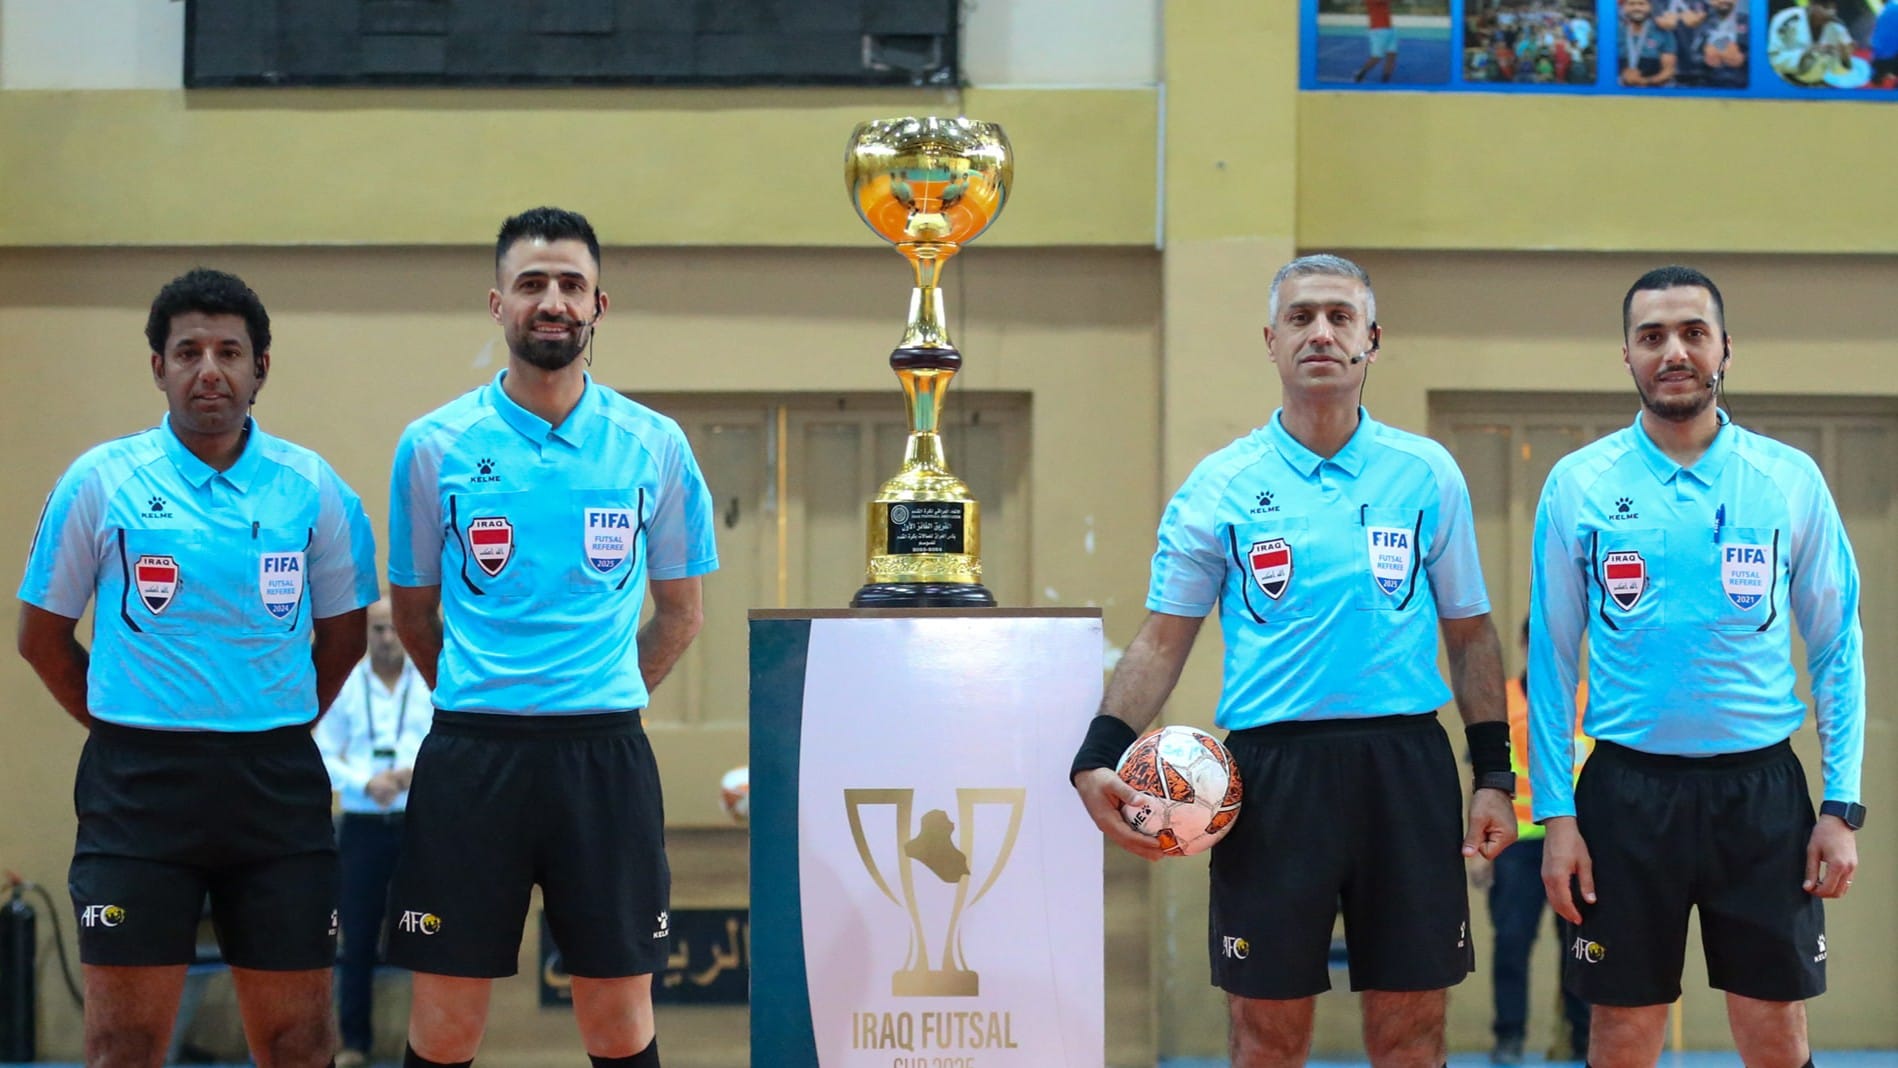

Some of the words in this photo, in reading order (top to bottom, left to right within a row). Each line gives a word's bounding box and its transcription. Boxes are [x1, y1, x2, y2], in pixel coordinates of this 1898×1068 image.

[470, 475, 501, 483] KELME
[1250, 506, 1280, 514] KELME
[590, 513, 629, 528] FIFA
[1608, 513, 1639, 521] KELME
[477, 520, 503, 528] IRAQ
[595, 535, 623, 544] FUTSAL
[1372, 531, 1408, 549] FIFA
[592, 543, 624, 551] REFEREE
[1257, 543, 1282, 552] IRAQ
[1378, 554, 1403, 563] FUTSAL
[1611, 554, 1636, 562] IRAQ
[1726, 547, 1766, 564] FIFA
[143, 558, 170, 566] IRAQ
[264, 556, 299, 573] FIFA
[1731, 570, 1760, 579] FUTSAL
[1729, 578, 1762, 587] REFEREE
[1736, 595, 1754, 603] 2021
[80, 904, 125, 927] AFC
[398, 910, 441, 935] AFC
[852, 1011, 914, 1051] IRAQ
[921, 1011, 1018, 1049] FUTSAL
